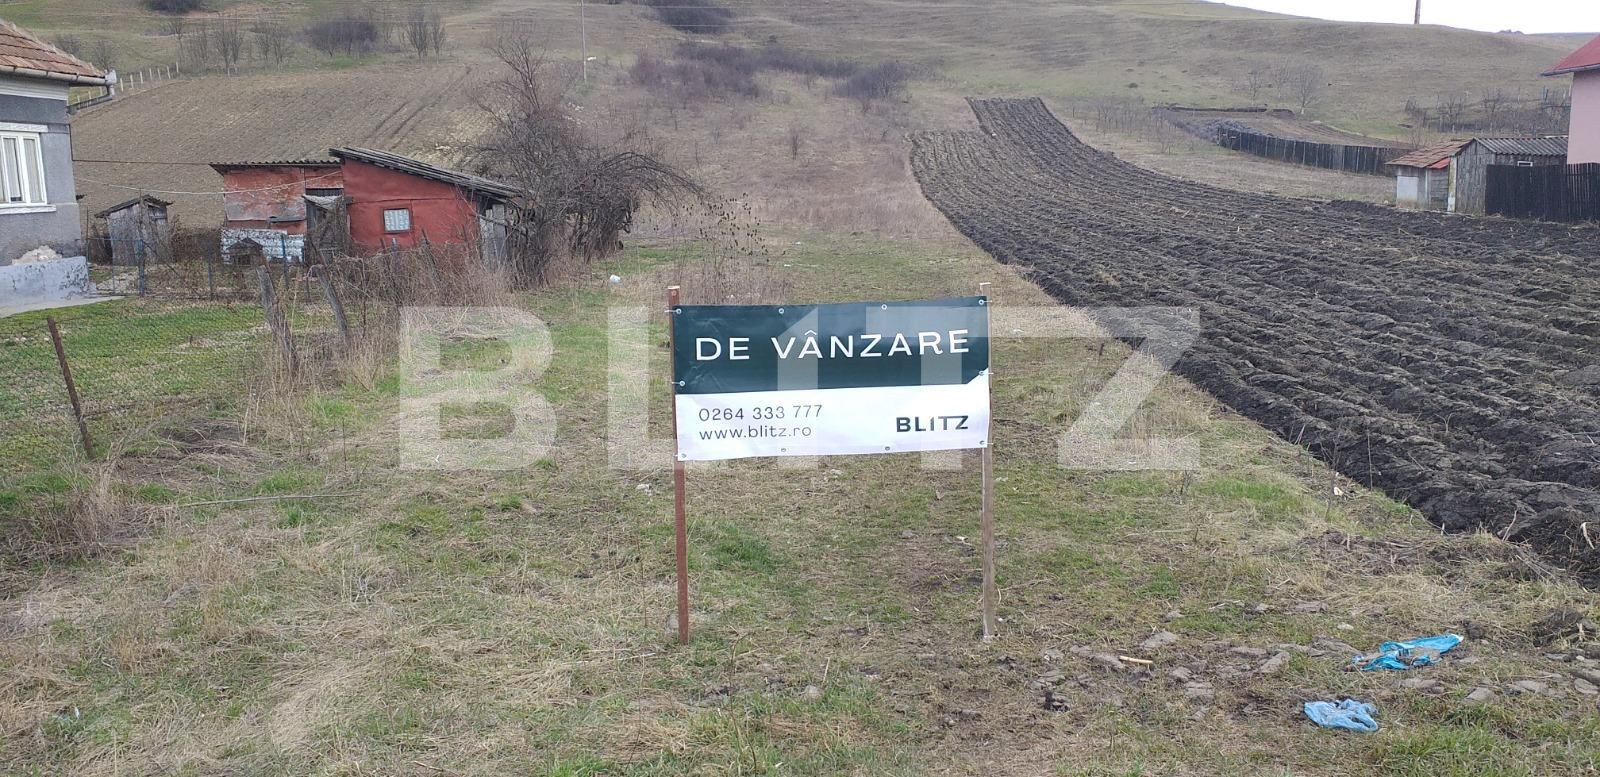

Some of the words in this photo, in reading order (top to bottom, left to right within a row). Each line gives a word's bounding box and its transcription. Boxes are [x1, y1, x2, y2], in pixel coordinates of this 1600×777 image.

[696, 337, 750, 361] DE
[771, 329, 970, 360] VÂNZARE
[698, 407, 744, 422] 0264
[752, 406, 785, 420] 333
[792, 404, 823, 418] 777
[699, 424, 812, 441] www.blitz.ro
[896, 415, 969, 433] BLITZ
